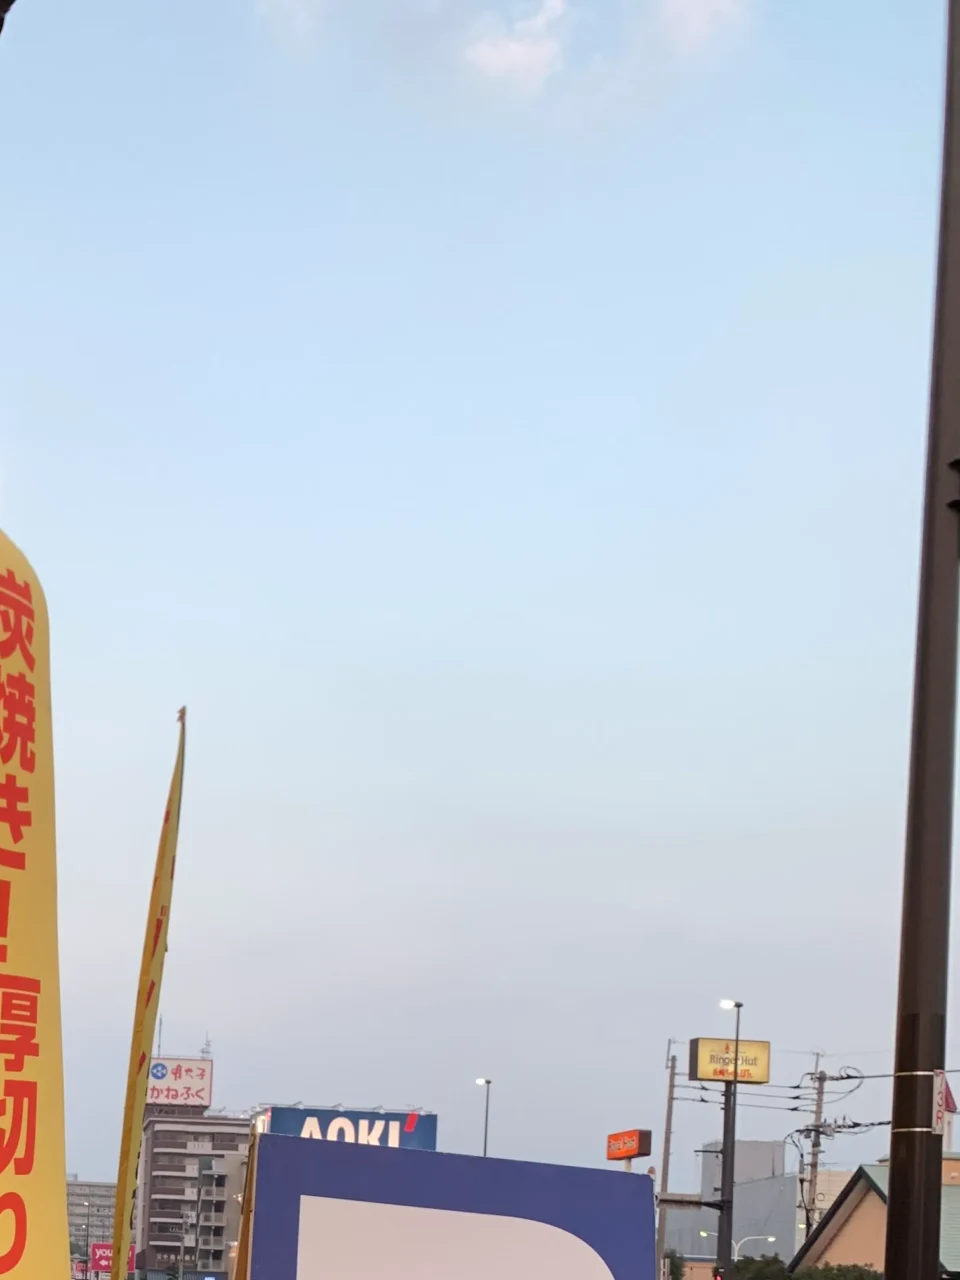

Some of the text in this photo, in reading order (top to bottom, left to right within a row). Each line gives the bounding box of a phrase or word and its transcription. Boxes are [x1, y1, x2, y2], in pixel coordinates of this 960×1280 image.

[150, 1085, 205, 1101] かねふく
[300, 1116, 400, 1148] AOKI
